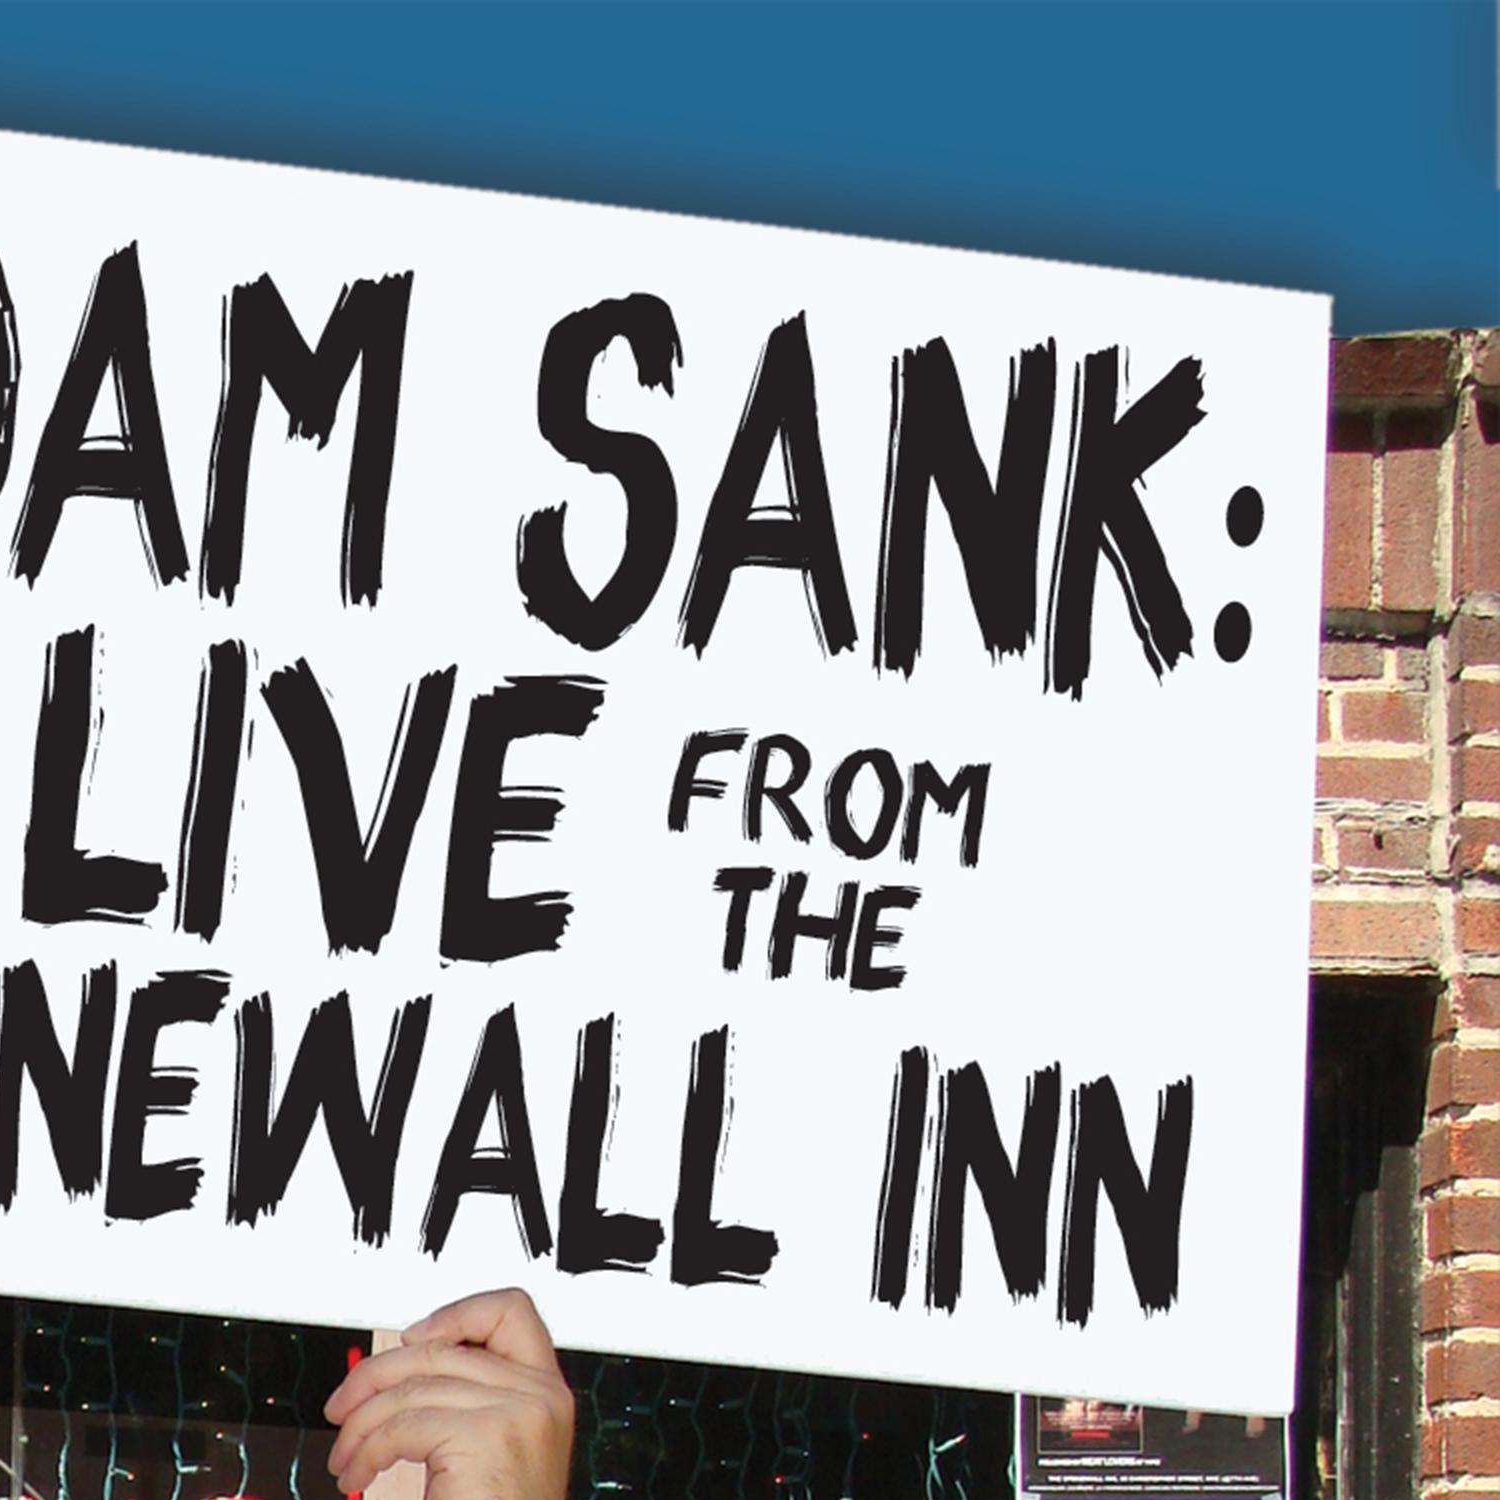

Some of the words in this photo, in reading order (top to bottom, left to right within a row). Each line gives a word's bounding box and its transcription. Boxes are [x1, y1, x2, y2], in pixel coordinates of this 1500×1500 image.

[517, 293, 1264, 701] SANK:
[22, 624, 606, 962] LIVE
[668, 732, 990, 868] FROM
[714, 867, 921, 990] THE
[872, 1046, 1192, 1328] INN
